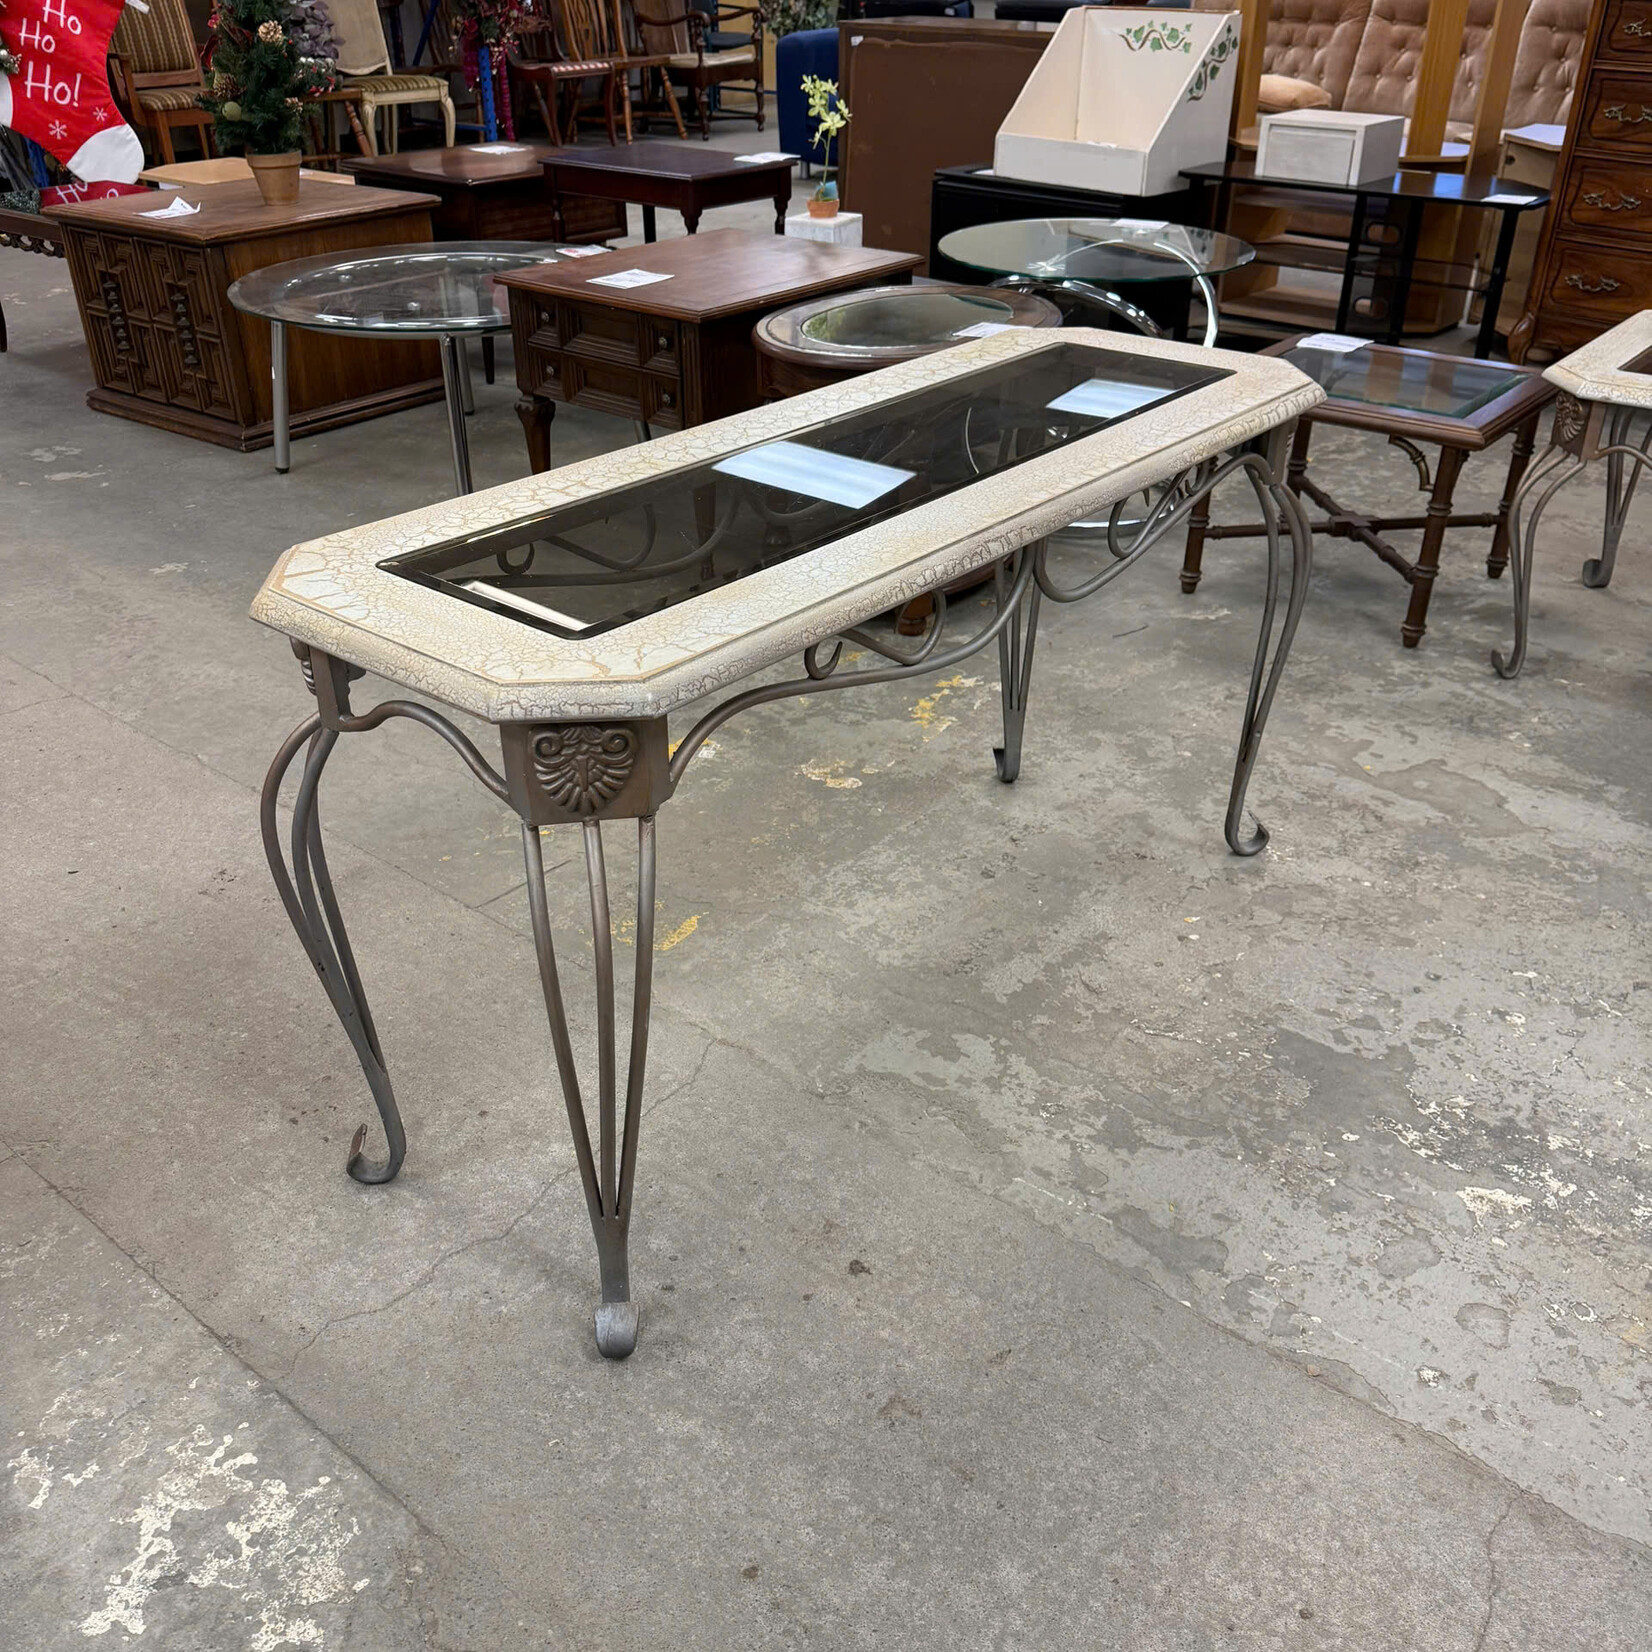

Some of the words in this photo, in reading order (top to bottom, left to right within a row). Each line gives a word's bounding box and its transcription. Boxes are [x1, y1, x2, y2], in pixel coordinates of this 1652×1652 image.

[19, 17, 56, 53] Ho
[42, 0, 82, 35] Ho
[24, 60, 81, 107] Ho!
